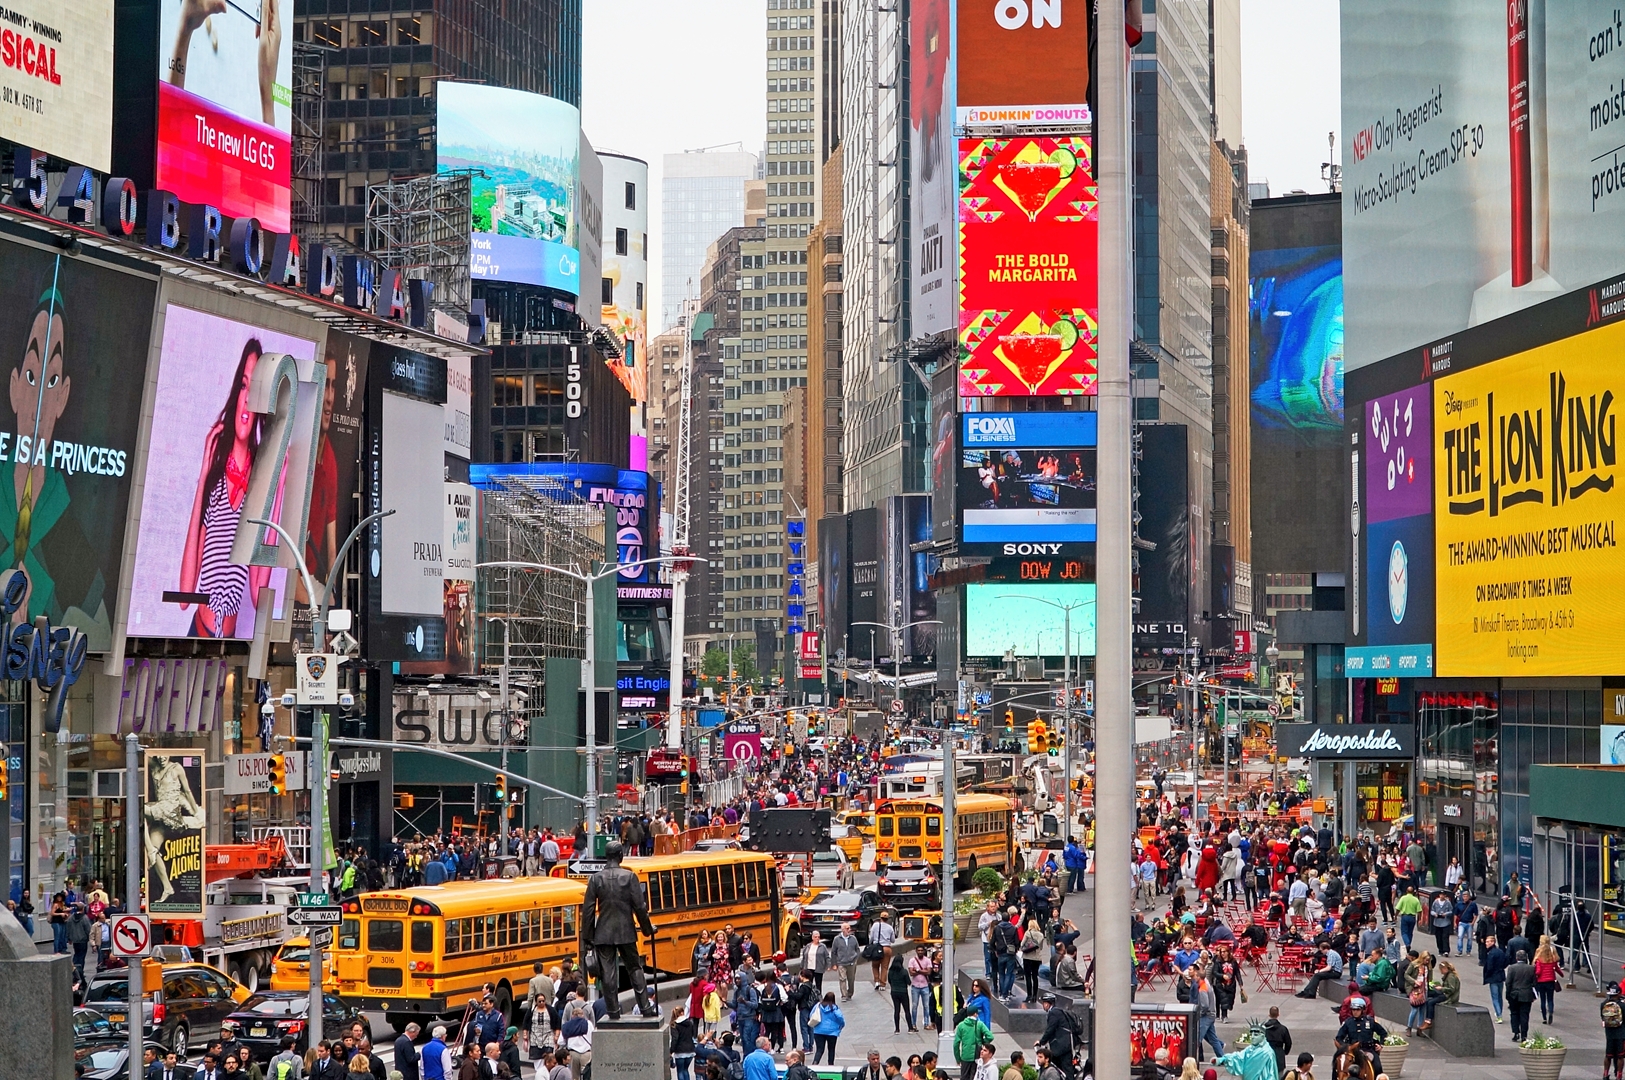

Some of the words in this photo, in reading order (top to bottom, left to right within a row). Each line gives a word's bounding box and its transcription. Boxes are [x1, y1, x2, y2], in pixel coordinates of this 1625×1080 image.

[994, 0, 1062, 29] ON
[32, 20, 62, 43] WINNING
[1590, 9, 1623, 62] can't
[0, 27, 61, 86] SICAL
[1591, 79, 1625, 132] moist
[979, 110, 1034, 121] DUNKIN'
[1035, 109, 1088, 120] DONUTS
[1353, 125, 1373, 164] NEW
[1375, 119, 1394, 152] Olay
[1396, 84, 1442, 141] Regenerist
[195, 114, 216, 148] The
[218, 131, 240, 157] new
[243, 134, 257, 164] LG
[259, 141, 275, 170] G5
[1354, 165, 1416, 216] Micro-Sculpting
[1418, 147, 1448, 181] Cream
[1450, 123, 1468, 165] SPF
[1471, 123, 1484, 157] 30
[472, 239, 491, 250] York
[477, 255, 491, 265] PM
[921, 236, 943, 277] ANTI
[995, 254, 1025, 268] THE
[1029, 253, 1069, 267] BOLD
[470, 266, 487, 277] May
[490, 266, 499, 276] 17
[988, 268, 1078, 282] MARGARITA
[1432, 341, 1453, 357] MARRIOTT
[1432, 357, 1451, 373] MARQUIS
[566, 346, 581, 419] 1500
[968, 418, 1005, 434] FOX
[1549, 369, 1617, 507] KING
[15, 433, 32, 465] IS
[33, 438, 47, 467] A
[51, 440, 127, 478] PRINCESS
[1444, 421, 1482, 498] THE
[1487, 391, 1543, 517] LION
[413, 542, 443, 562] PRADA
[1003, 543, 1063, 556] SONY
[1448, 541, 1464, 566] THE
[1466, 530, 1545, 564] AWARD-WINNING
[1547, 527, 1569, 553] BEST
[1570, 520, 1617, 551] MUSICAL
[423, 568, 443, 577] EYEWEAR
[1020, 561, 1052, 579] DOW
[617, 587, 662, 599] YEWITNESS
[1476, 585, 1486, 603] ON
[1487, 581, 1520, 601] BROADWAY
[1522, 581, 1527, 599] 8
[1528, 579, 1546, 598] TIMES
[1546, 578, 1552, 596] A
[1553, 576, 1573, 595] WEEK
[1166, 624, 1184, 634] 10
[1480, 613, 1501, 633] Minskoff
[1522, 610, 1548, 635] Broadway
[1549, 610, 1554, 629] &
[1555, 608, 1568, 629] 45th
[1568, 608, 1575, 629] St
[1507, 638, 1539, 663] lionking.com
[1133, 658, 1165, 670] way
[117, 658, 228, 734] FOREVER
[1381, 684, 1396, 693] GO!
[621, 697, 656, 708] ESPN
[737, 725, 757, 733] NYC
[1300, 728, 1402, 754] Aéropostale
[238, 758, 253, 777] U.S.
[252, 780, 269, 789] SINCE
[1383, 786, 1402, 800] STORE
[164, 835, 200, 861] SHUFFLE
[169, 853, 200, 881] ALONG
[301, 894, 309, 905] W
[366, 900, 393, 911] SCHOOL
[394, 900, 407, 911] BUS
[294, 912, 310, 920] ONE
[320, 912, 337, 920] WAY
[381, 956, 395, 964] 3016
[1153, 1020, 1185, 1040] BOYS
